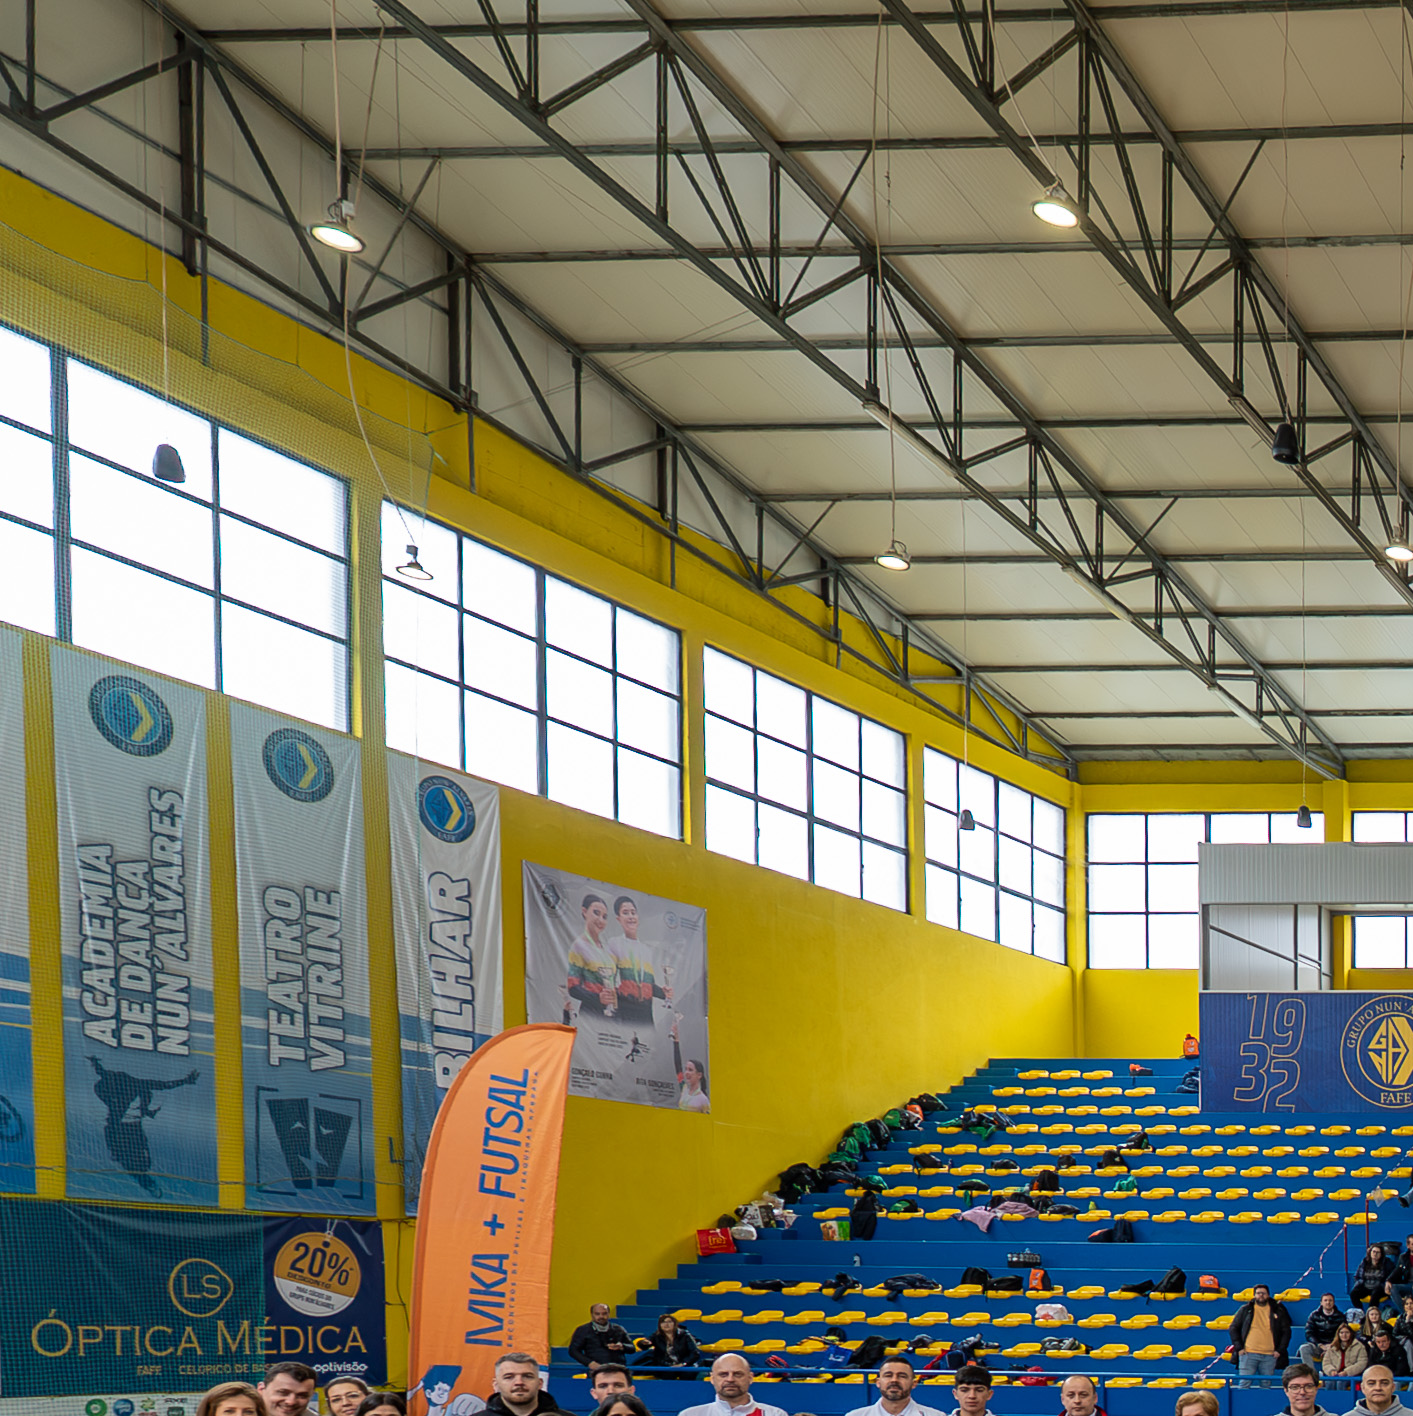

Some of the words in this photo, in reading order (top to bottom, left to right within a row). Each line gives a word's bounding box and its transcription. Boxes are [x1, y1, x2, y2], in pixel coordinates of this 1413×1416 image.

[77, 843, 118, 1049] ACADEMIA
[115, 859, 152, 994] DANÇA
[263, 885, 307, 1067] TEATRO
[304, 886, 345, 1072] VITRINE
[428, 871, 475, 1090] BILHAR
[120, 996, 155, 1051] DE
[1346, 1009, 1374, 1048] GRUPO
[1380, 1092, 1411, 1104] FAFE
[478, 1068, 529, 1200] FUTSAL
[181, 1274, 221, 1299] LS
[464, 1253, 510, 1347] MKA
[32, 1308, 204, 1356] ÓPTICA
[217, 1315, 368, 1356] MÉDICA
[136, 1364, 162, 1376] FAFE
[178, 1363, 232, 1375] CELORICO
[234, 1363, 250, 1374] DE
[312, 1362, 368, 1375] optivisão
